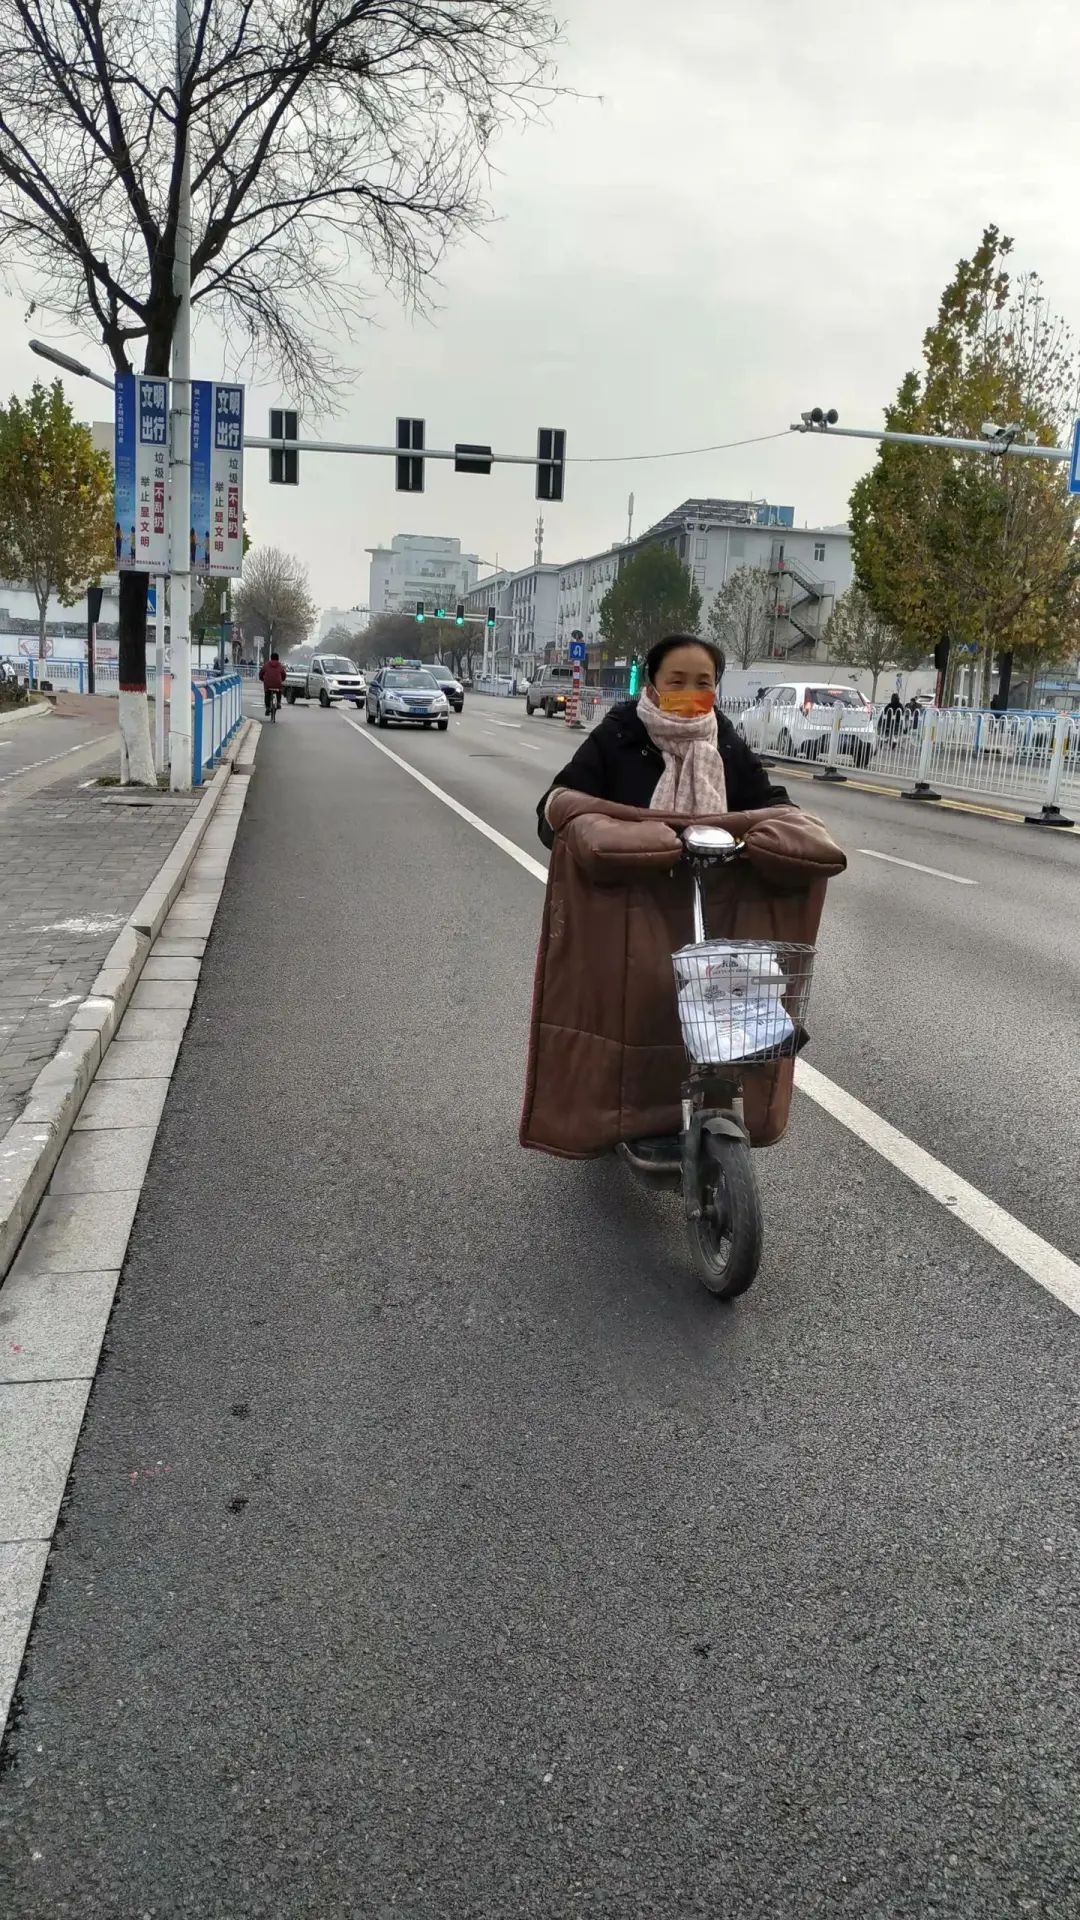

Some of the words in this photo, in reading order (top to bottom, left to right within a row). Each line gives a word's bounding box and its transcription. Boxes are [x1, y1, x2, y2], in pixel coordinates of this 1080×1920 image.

[141, 384, 165, 410] 文明
[217, 390, 241, 415] 文明
[142, 415, 165, 442] 出行
[217, 421, 240, 447] 出行
[140, 476, 150, 548] 举止显文明
[153, 452, 165, 529] 垃圾不乱扔
[228, 458, 239, 534] 垃圾不乱扔
[214, 481, 224, 553] 举止显文明
